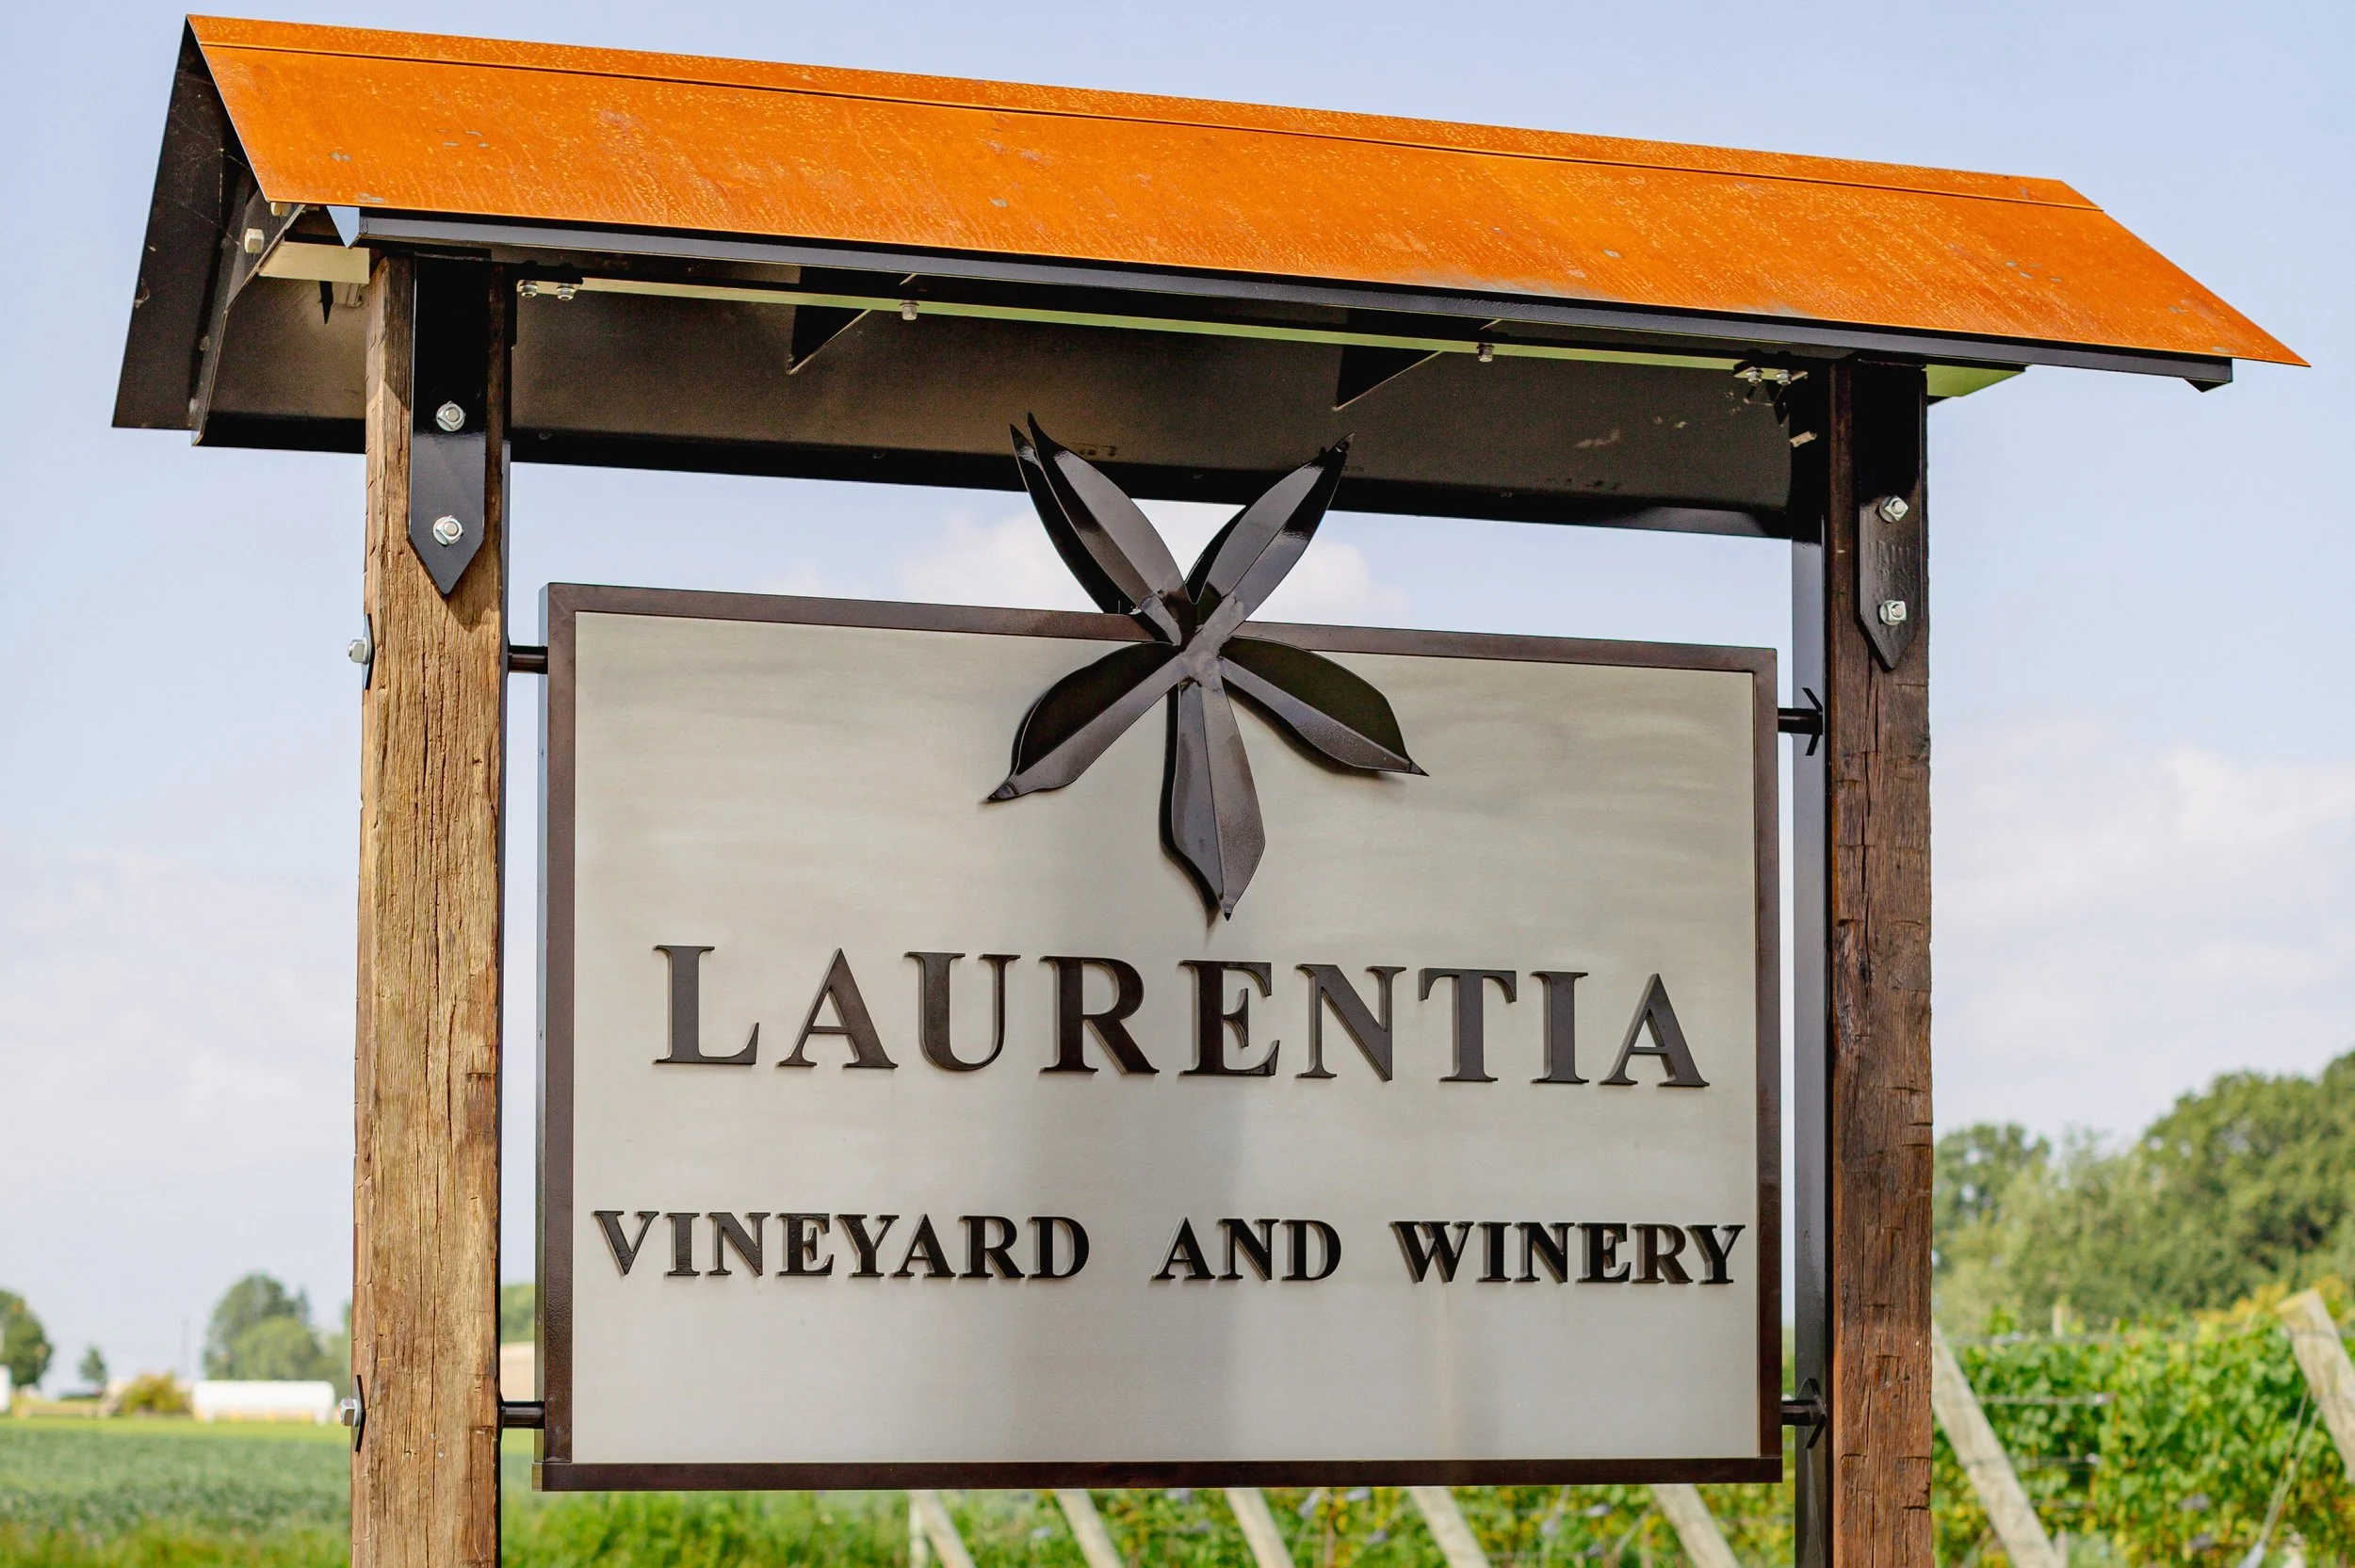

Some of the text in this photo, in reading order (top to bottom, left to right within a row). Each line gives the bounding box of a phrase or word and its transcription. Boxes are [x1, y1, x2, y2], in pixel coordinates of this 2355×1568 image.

[652, 944, 1712, 1090] LAURENTIA
[593, 1210, 1746, 1285] VINEYARD AND WINERY
